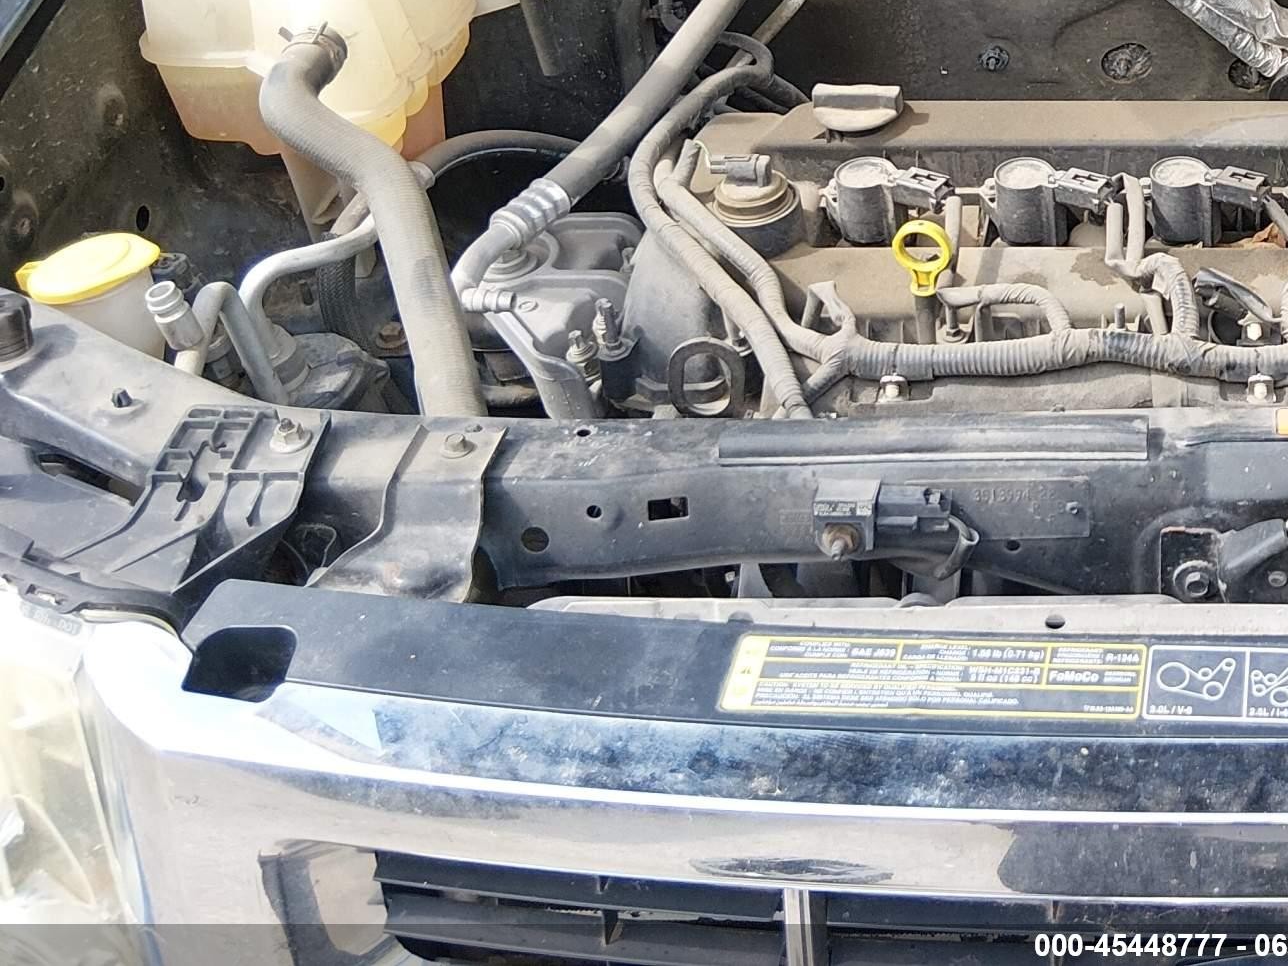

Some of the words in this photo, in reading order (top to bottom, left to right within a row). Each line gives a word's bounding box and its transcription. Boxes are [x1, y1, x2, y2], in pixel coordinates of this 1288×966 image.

[851, 648, 872, 656] SAE
[1105, 653, 1139, 663] R-134A
[1049, 670, 1099, 683] FoMoCo
